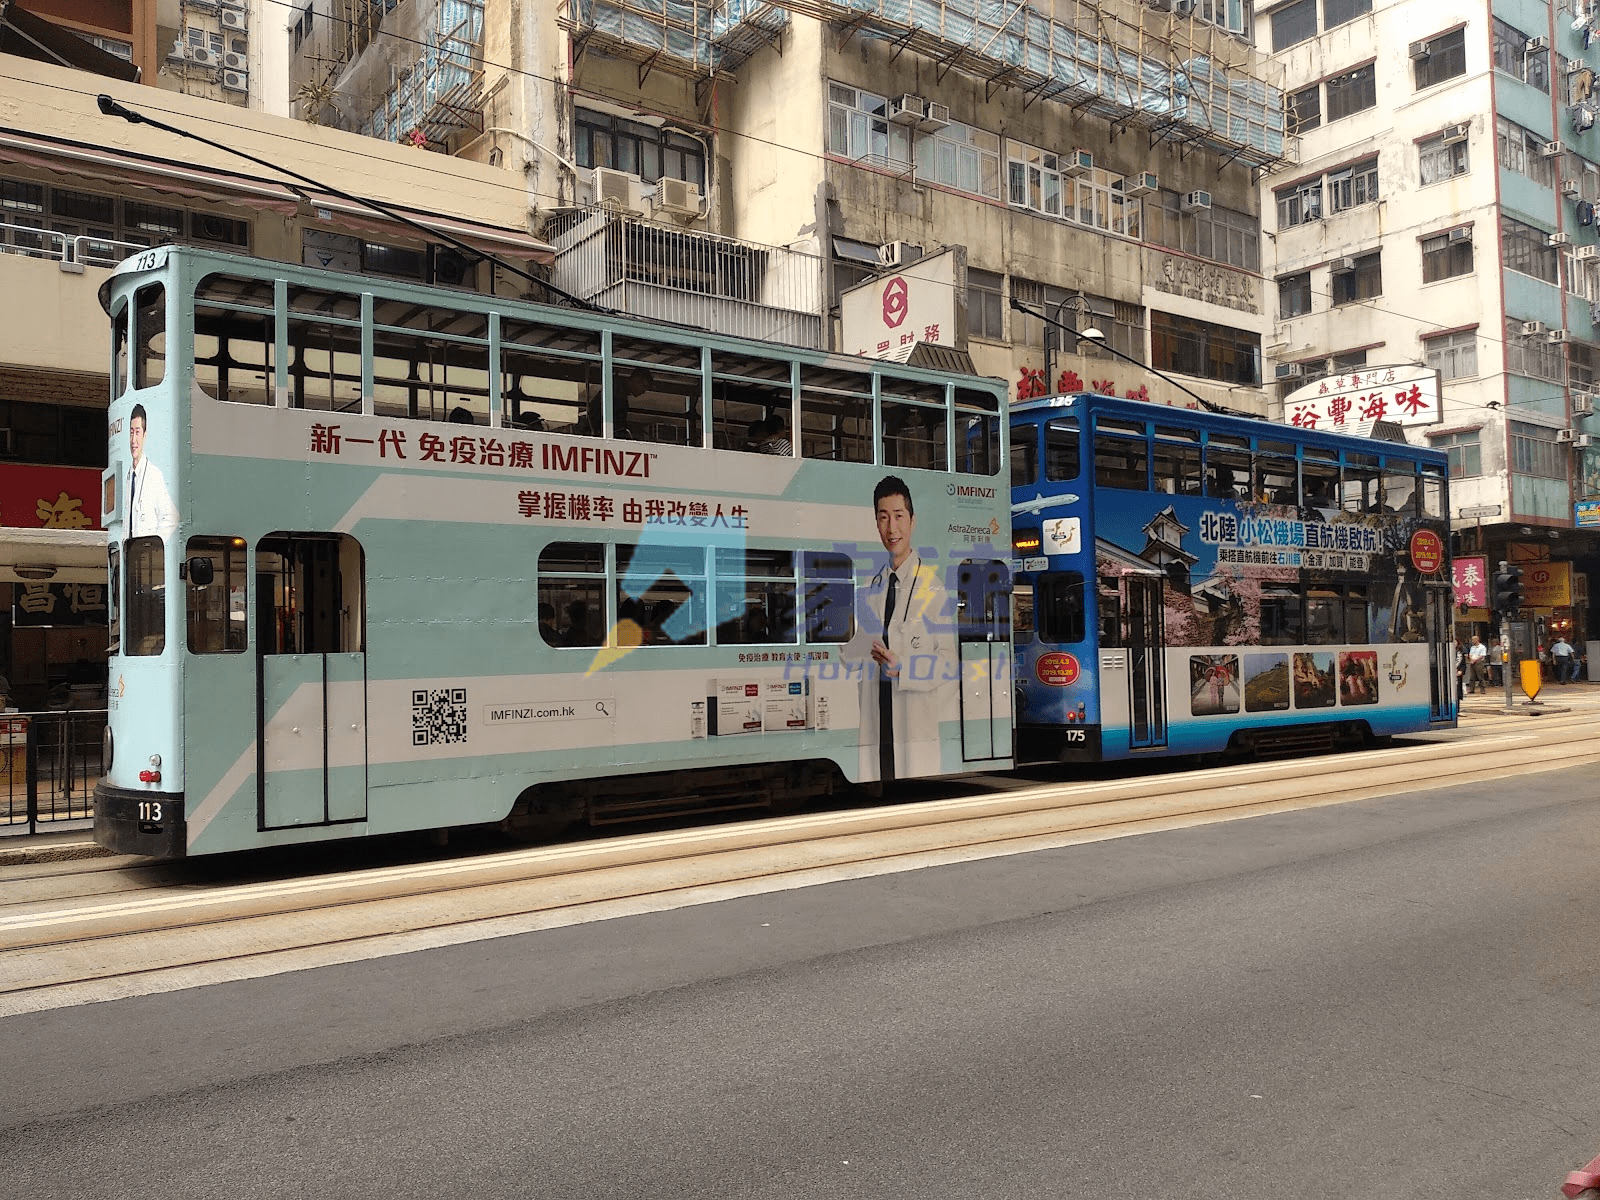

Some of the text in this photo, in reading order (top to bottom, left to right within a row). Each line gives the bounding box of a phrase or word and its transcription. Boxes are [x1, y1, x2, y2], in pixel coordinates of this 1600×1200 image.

[136, 252, 156, 271] 113
[1291, 384, 1431, 429] 裕豐海味
[310, 423, 407, 459] 新一代
[418, 432, 533, 469] 免疫治療
[517, 490, 750, 529] 掌握機率 由我改變人生
[947, 524, 991, 535] AstraZeneca
[1200, 513, 1237, 544] 北陸
[490, 706, 575, 721] IMFINZI.com.hk
[1066, 729, 1086, 742] 175
[138, 802, 162, 823] 113
